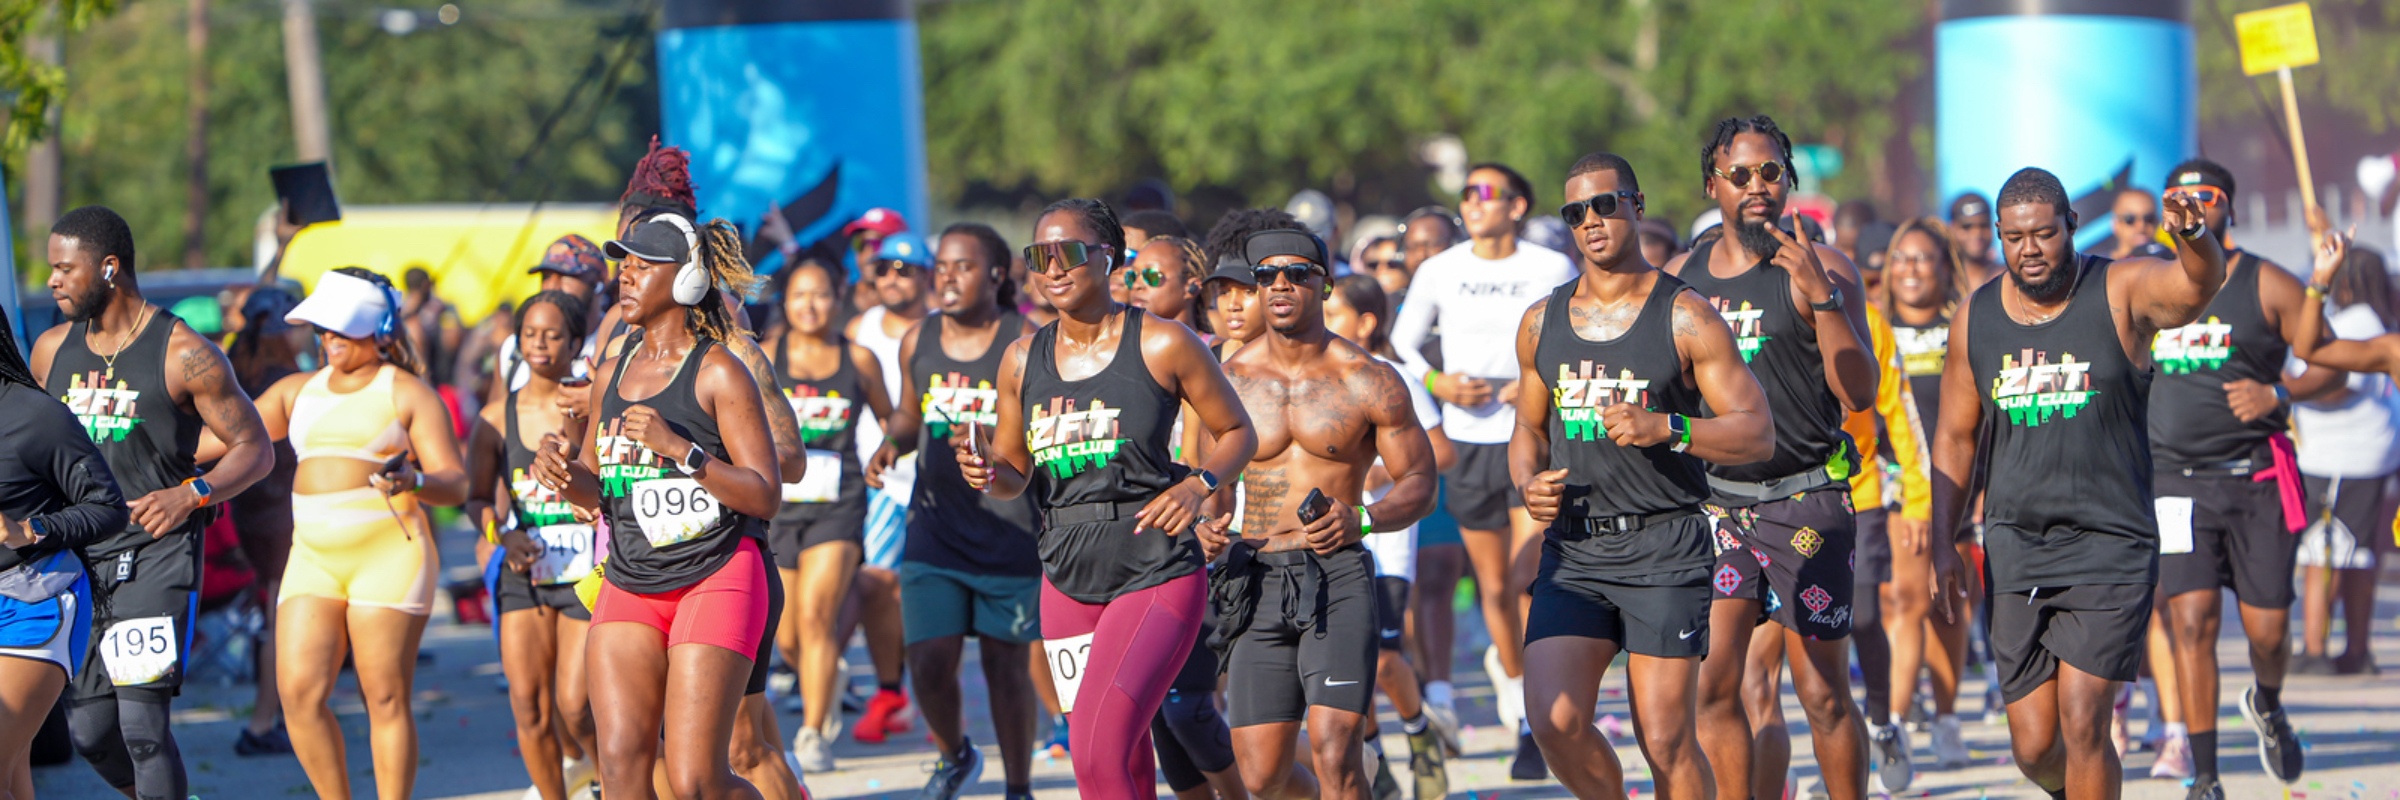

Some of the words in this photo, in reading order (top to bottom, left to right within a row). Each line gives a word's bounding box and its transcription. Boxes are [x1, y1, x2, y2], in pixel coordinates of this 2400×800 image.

[1459, 281, 1529, 298] NIKE
[2156, 324, 2232, 349] ZFT
[1557, 379, 1651, 408] ZFT
[1998, 362, 2091, 399] ZFT
[67, 388, 140, 415] ZFT
[928, 387, 998, 413] ZFT
[1999, 395, 2034, 410] RUN
[2037, 391, 2088, 407] CLUB
[1030, 408, 1121, 451] ZFT
[1035, 446, 1063, 466] RUN
[1067, 439, 1117, 457] CLUB
[641, 487, 710, 518] 096
[109, 625, 168, 658] 195
